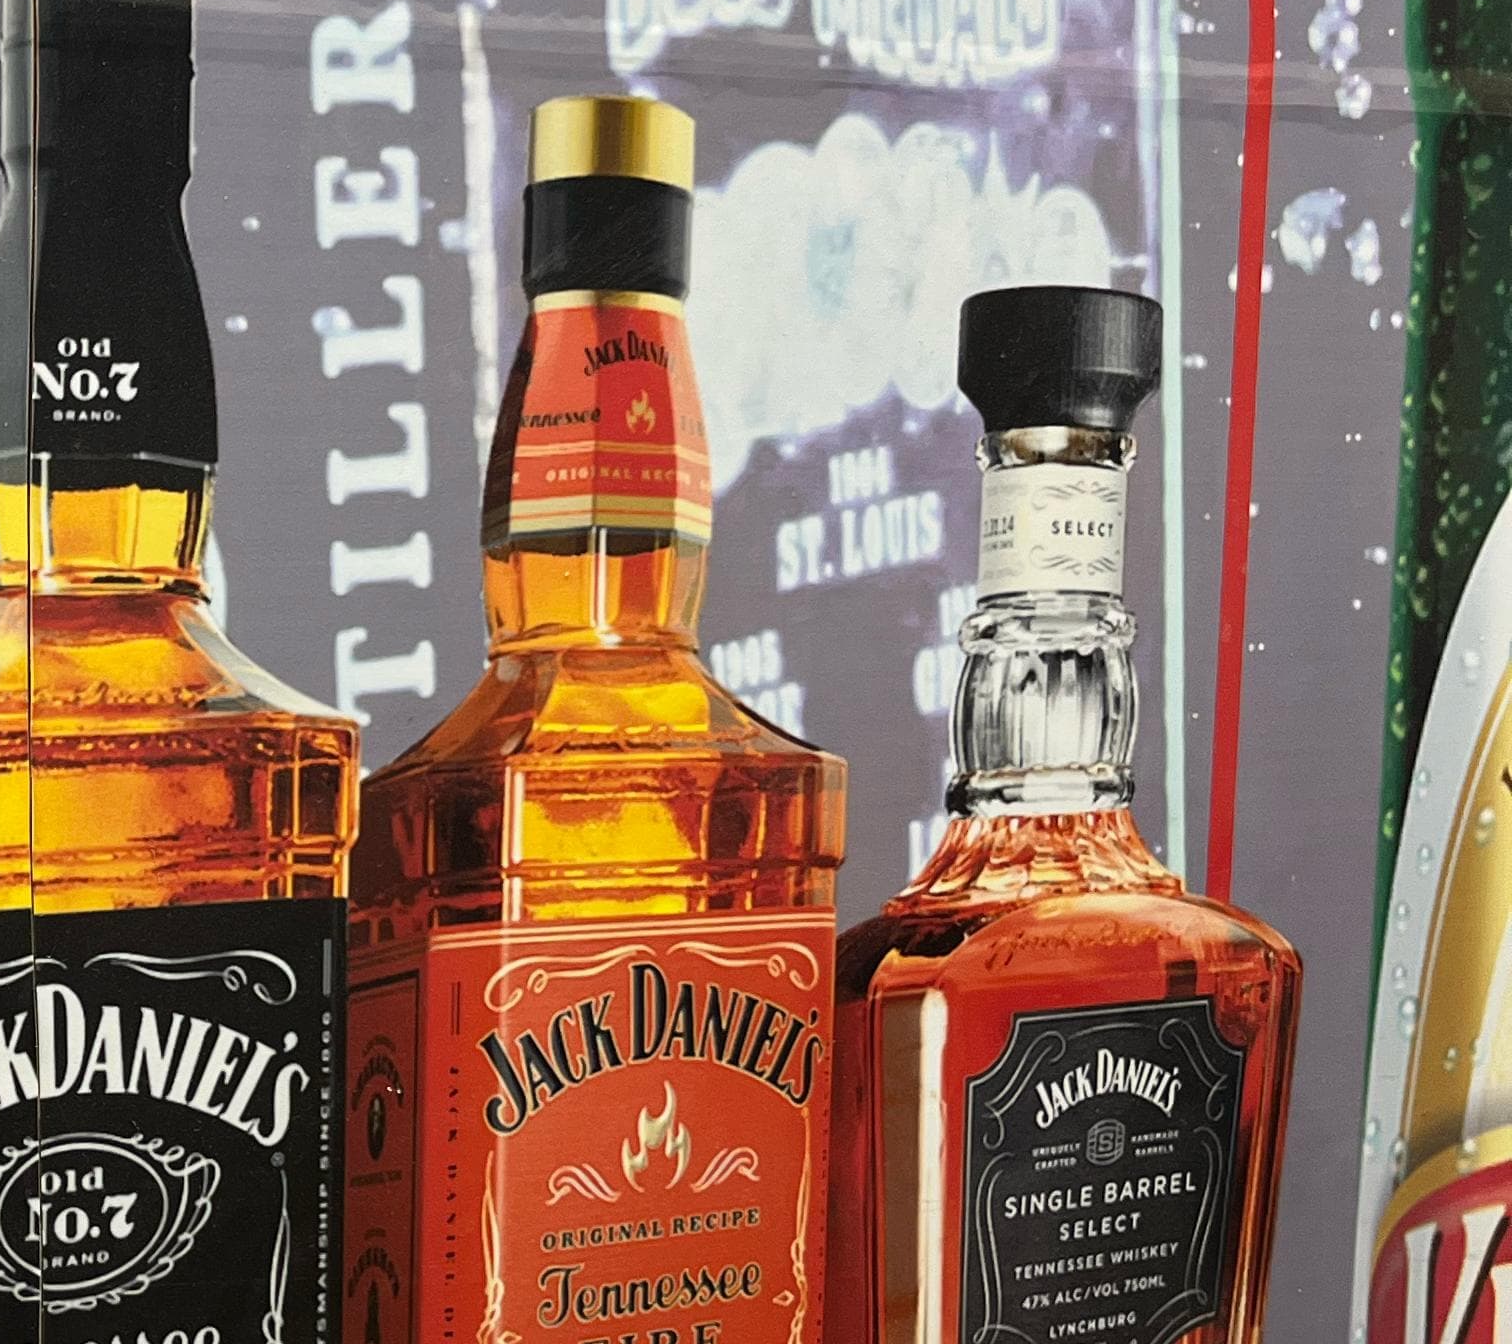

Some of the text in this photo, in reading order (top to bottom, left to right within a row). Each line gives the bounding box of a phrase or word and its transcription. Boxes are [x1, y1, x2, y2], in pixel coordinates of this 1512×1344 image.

[57, 337, 112, 358] Old
[584, 336, 625, 377] JACK
[31, 361, 140, 402] No.7
[776, 509, 834, 593] ST.
[839, 488, 945, 579] LOUIS
[1050, 519, 1114, 538] SELECT
[35, 982, 312, 1148] DANIEL'S
[476, 961, 825, 1137] JACK DANIEL'S
[1035, 1047, 1182, 1129] JACK DANIEL'S
[40, 1166, 105, 1197] Old
[1003, 1170, 1197, 1220] SINGLE BARREL
[541, 1207, 761, 1252] ORIGINAL RECIPE
[1059, 1212, 1142, 1242] SELECT
[1014, 1241, 1180, 1281] TENNESSEE WHISKEY
[538, 1261, 761, 1329] Tennessee
[1021, 1274, 1166, 1311] 47% ALC/VOL 750ML
[1049, 1310, 1137, 1339] LYNCHBURG
